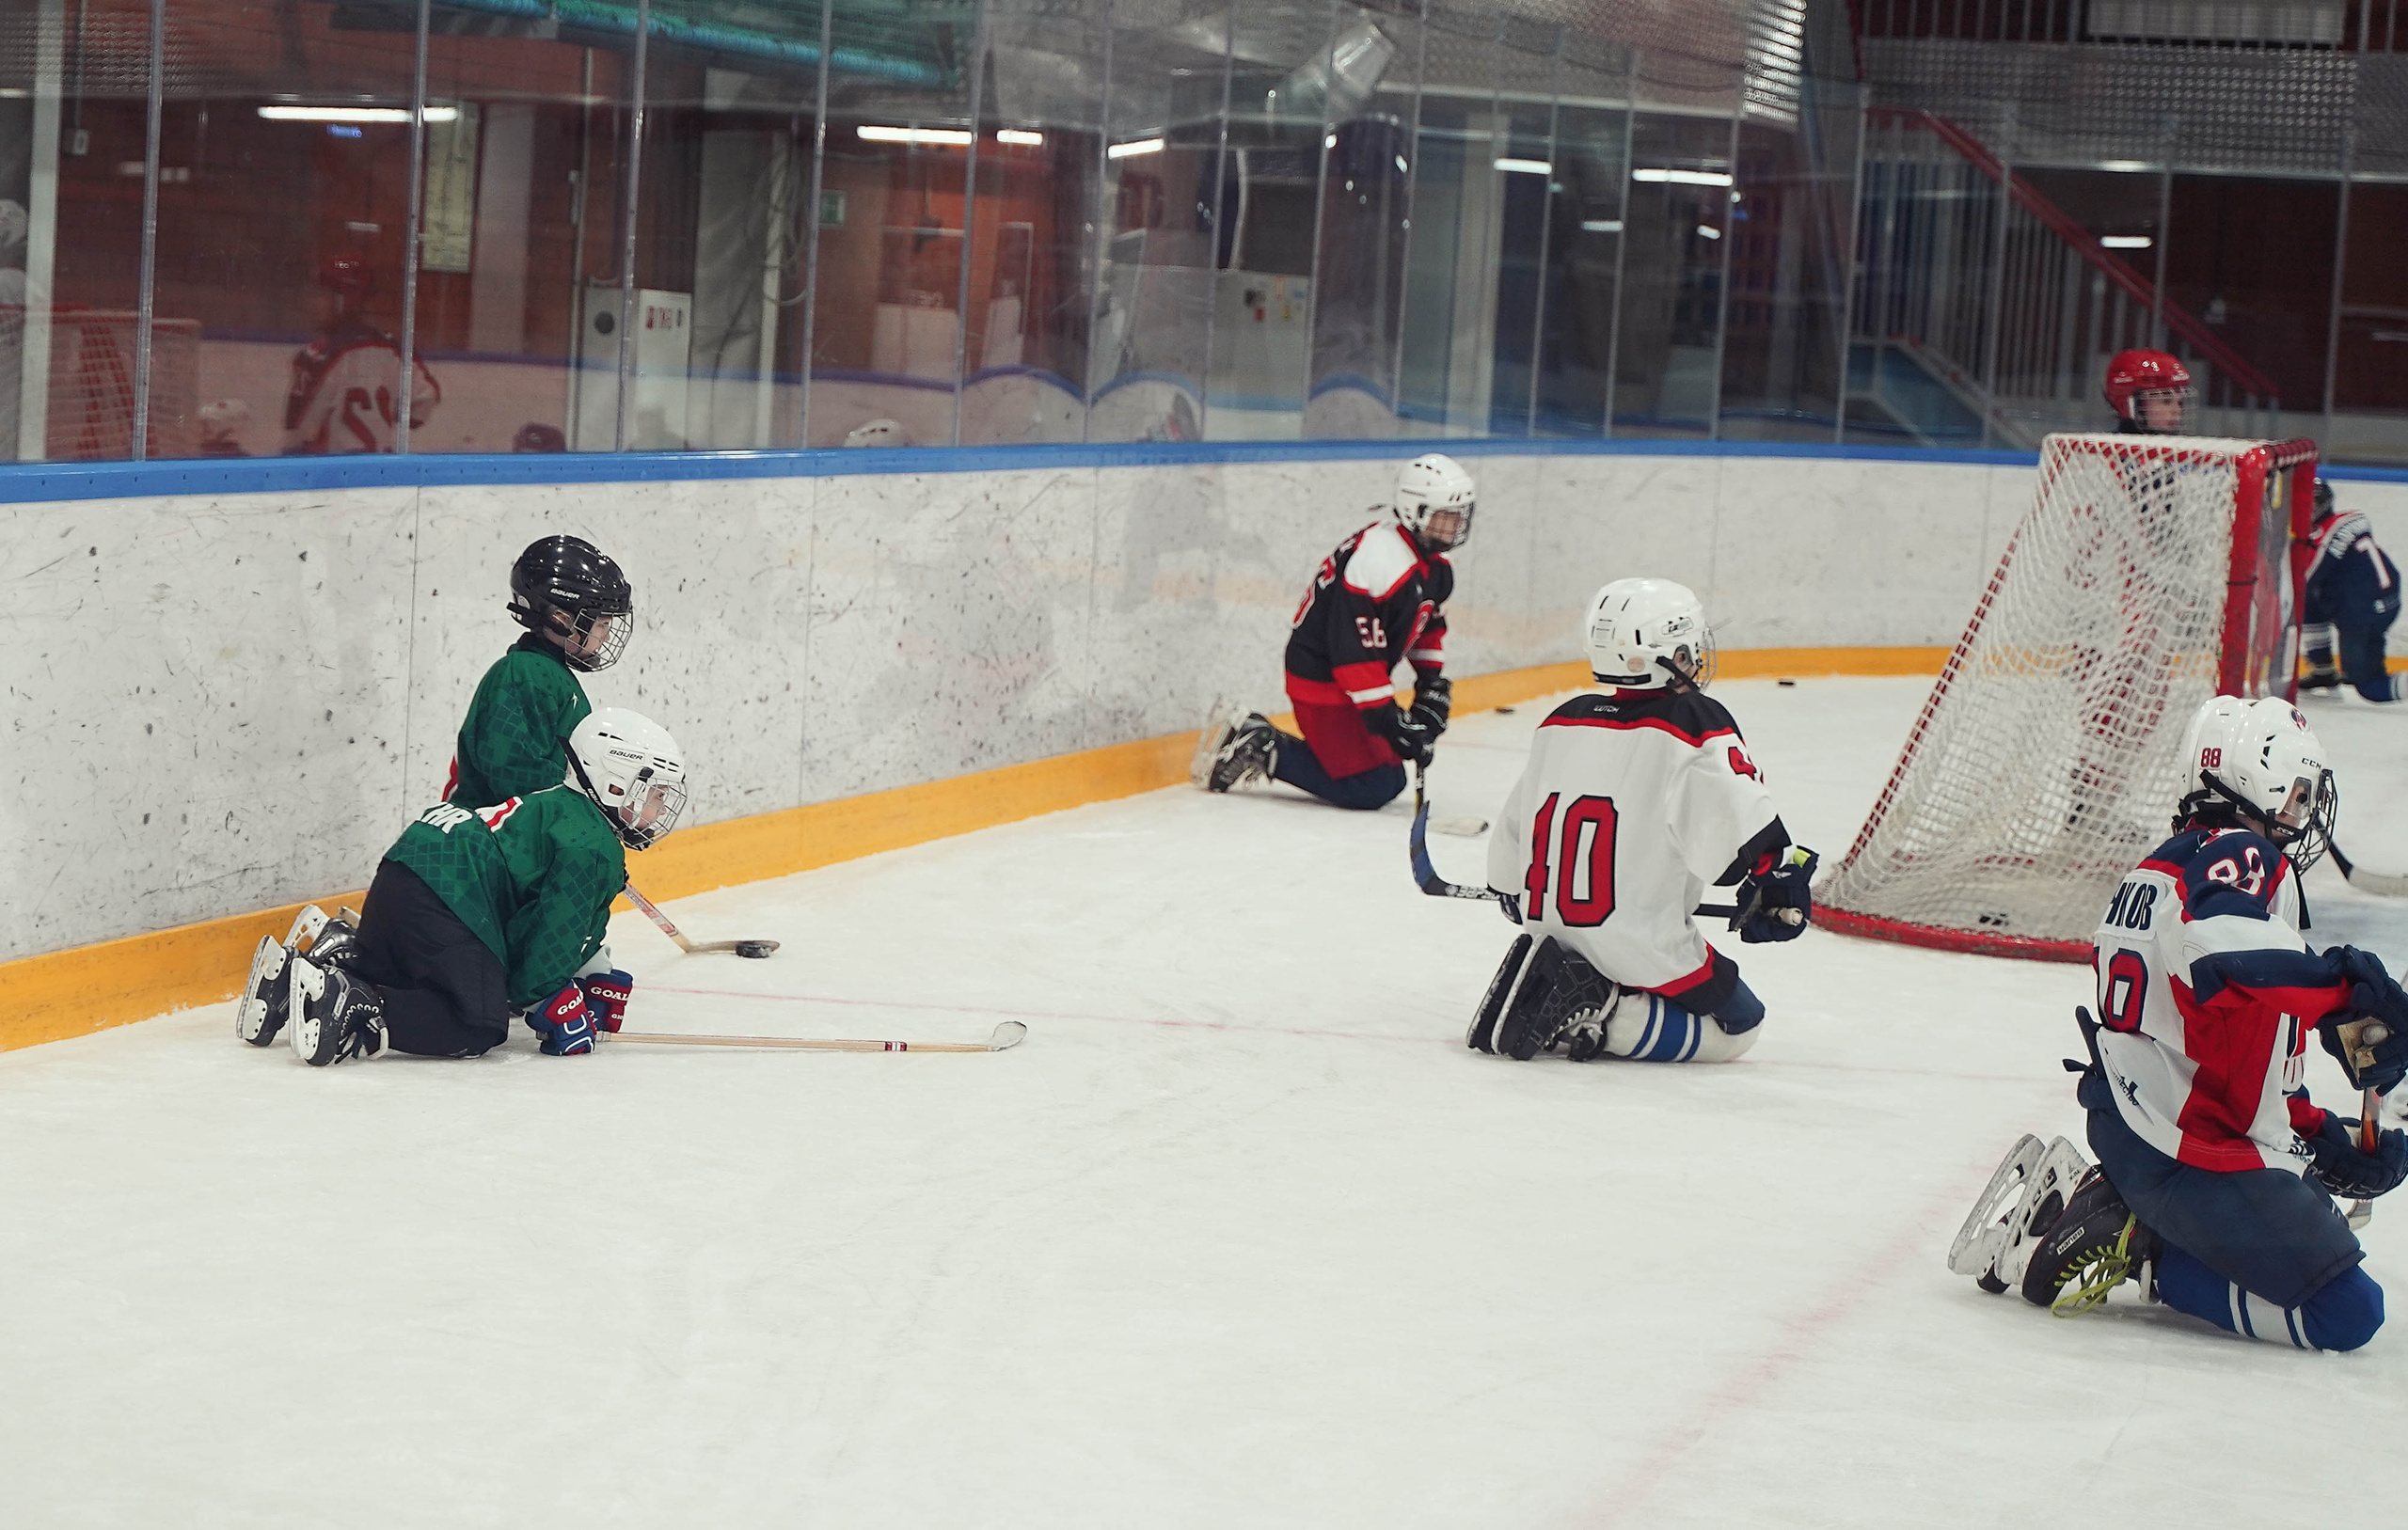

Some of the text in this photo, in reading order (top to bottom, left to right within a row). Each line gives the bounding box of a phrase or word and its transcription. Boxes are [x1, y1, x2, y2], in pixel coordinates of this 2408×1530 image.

[549, 588, 580, 600] BAUER
[609, 749, 643, 761] BAUER
[2200, 748, 2222, 768] 88
[2301, 757, 2323, 770] CCM
[2275, 826, 2294, 837] CCM
